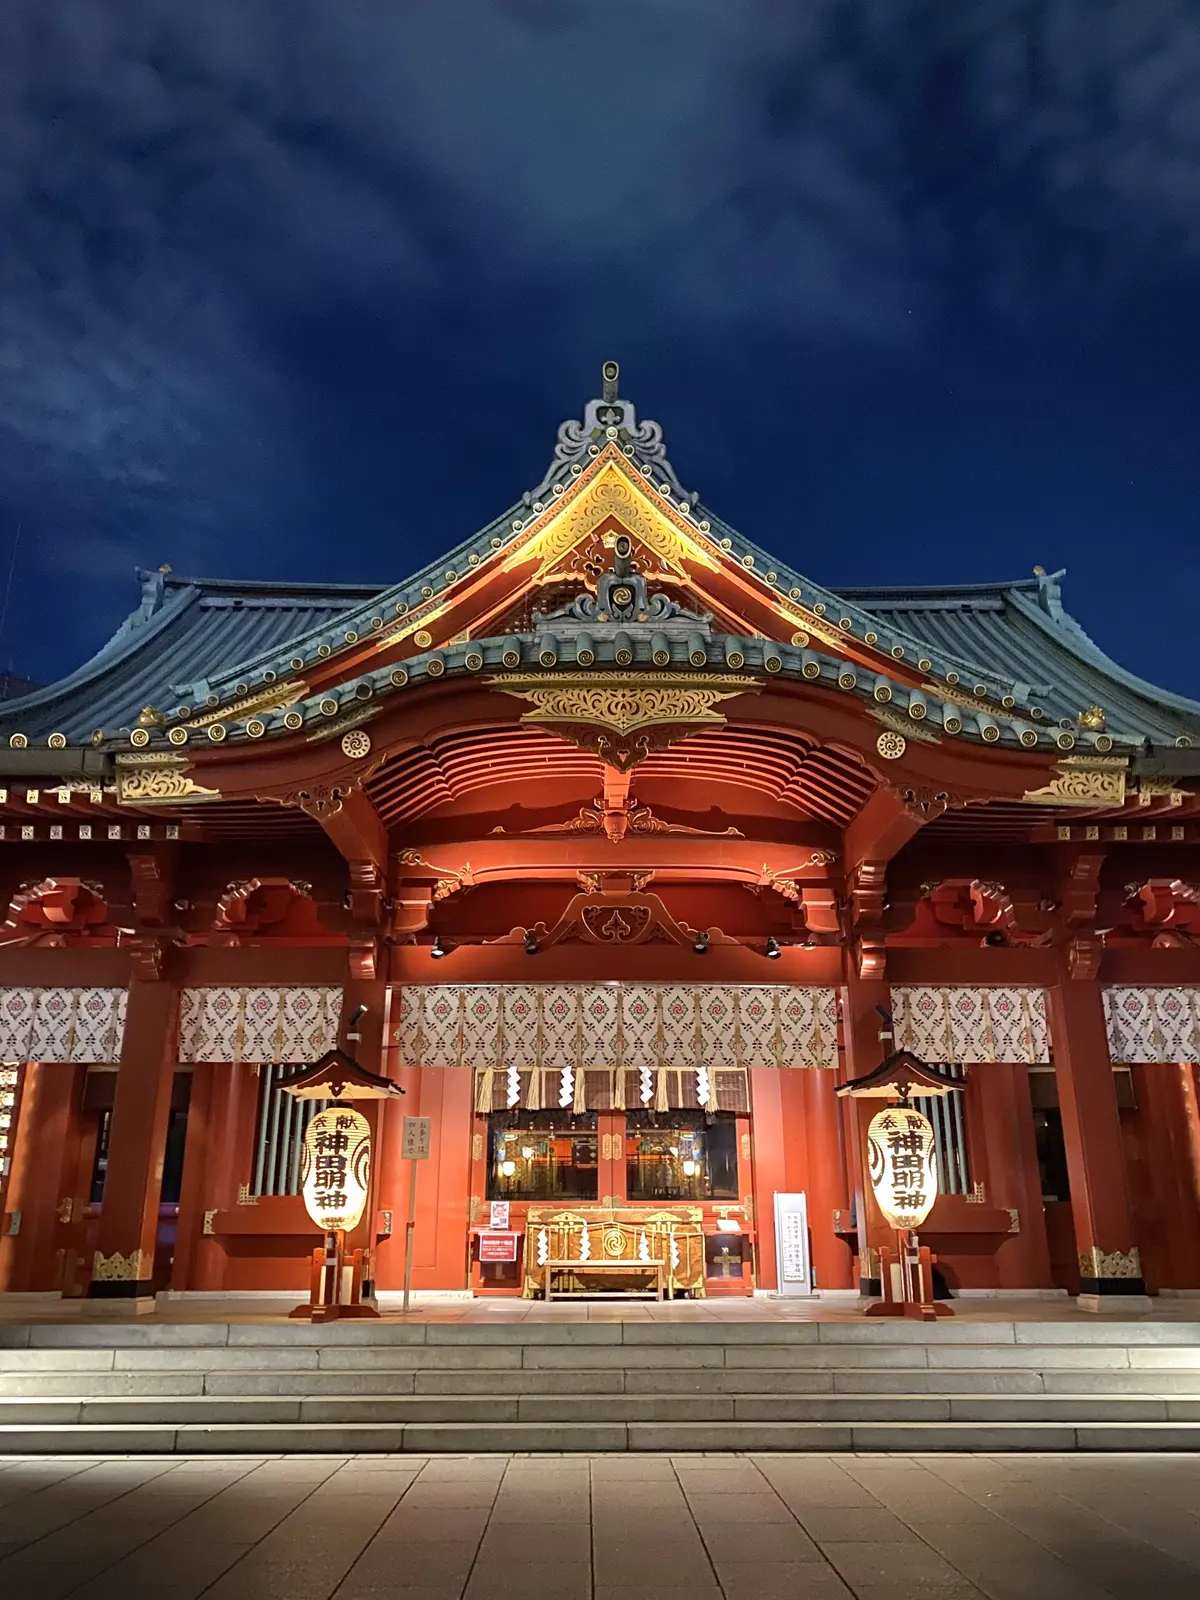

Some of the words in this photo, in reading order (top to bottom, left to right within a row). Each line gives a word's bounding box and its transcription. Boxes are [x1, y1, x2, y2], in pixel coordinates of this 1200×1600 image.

[313, 1130, 349, 1210] 神田明神
[887, 1130, 926, 1210] 神田明神
